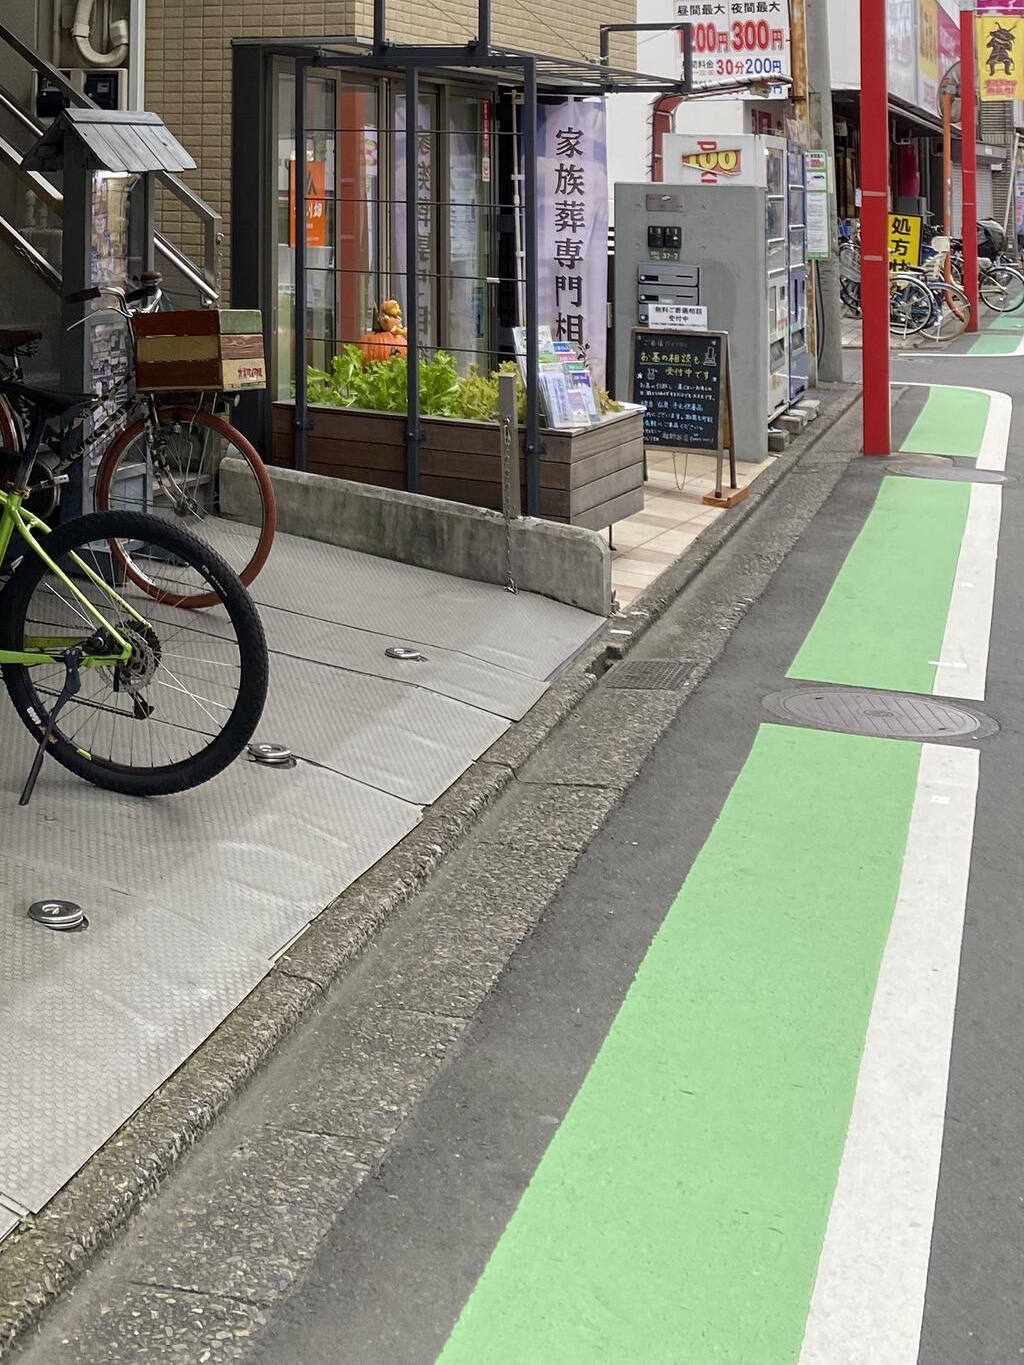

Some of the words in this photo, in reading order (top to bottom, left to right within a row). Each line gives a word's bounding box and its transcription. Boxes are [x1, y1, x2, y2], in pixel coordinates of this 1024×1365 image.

[677, 4, 725, 16] 昼間最大
[731, 1, 780, 14] 夜間最大
[732, 20, 784, 50] 300円
[640, 351, 700, 365] お墓の相談も
